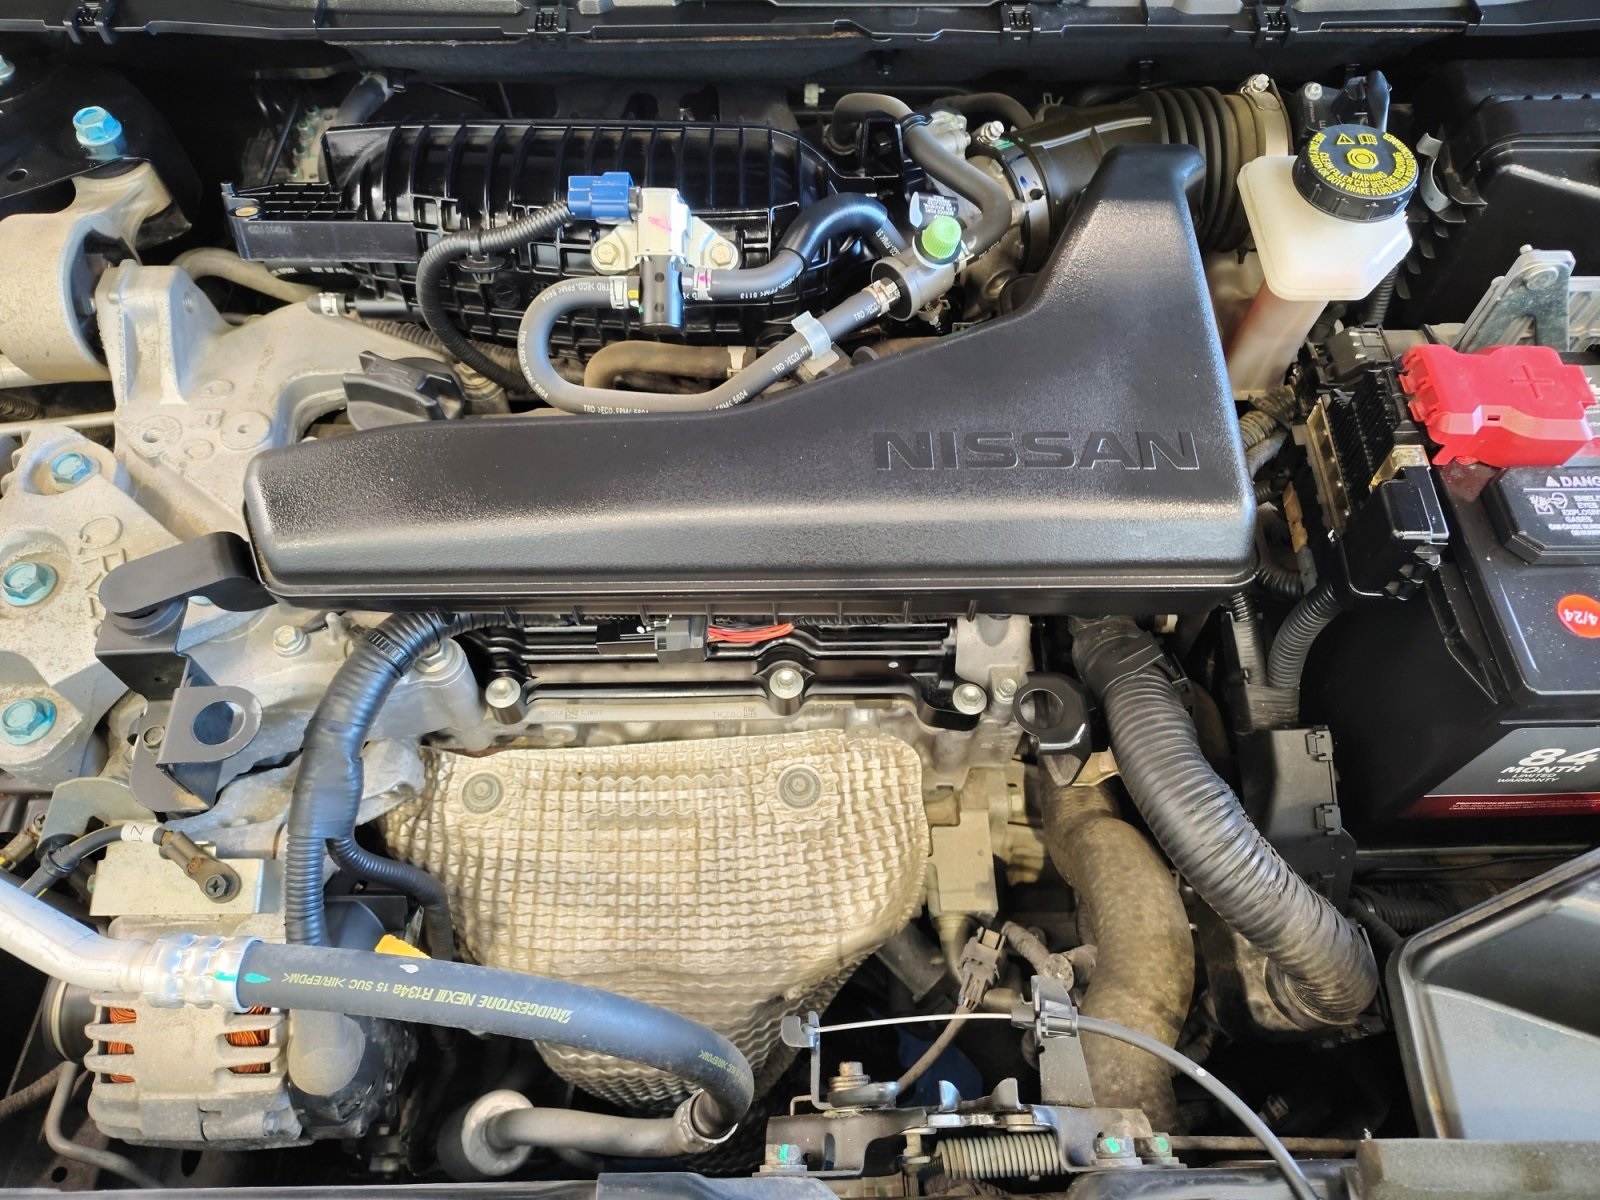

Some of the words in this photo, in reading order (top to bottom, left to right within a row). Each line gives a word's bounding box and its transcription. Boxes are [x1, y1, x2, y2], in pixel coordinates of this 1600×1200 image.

[1382, 132, 1414, 159] CONTAINER
[1318, 167, 1330, 177] OR
[1319, 152, 1335, 170] CLEAN
[1329, 167, 1353, 184] FILLER
[1353, 179, 1370, 189] CAP
[1370, 175, 1398, 189] BEFORE
[1350, 170, 1388, 181] WARNING
[1326, 174, 1345, 188] DOT4
[1390, 178, 1409, 192] FROM
[1345, 182, 1370, 195] BRAKE
[1370, 186, 1393, 196] FLUID
[853, 310, 866, 321] TRD
[772, 363, 785, 375] TRD
[873, 431, 1200, 470] NISSAN
[1560, 476, 1600, 488] DANG
[1563, 608, 1599, 626] 4/24
[1518, 748, 1600, 767] 84
[1500, 766, 1587, 774] MONTH
[348, 979, 374, 991] SUC
[375, 982, 389, 993] 15
[393, 983, 434, 1001] R134a
[477, 995, 574, 1025] BRIDGESTONE
